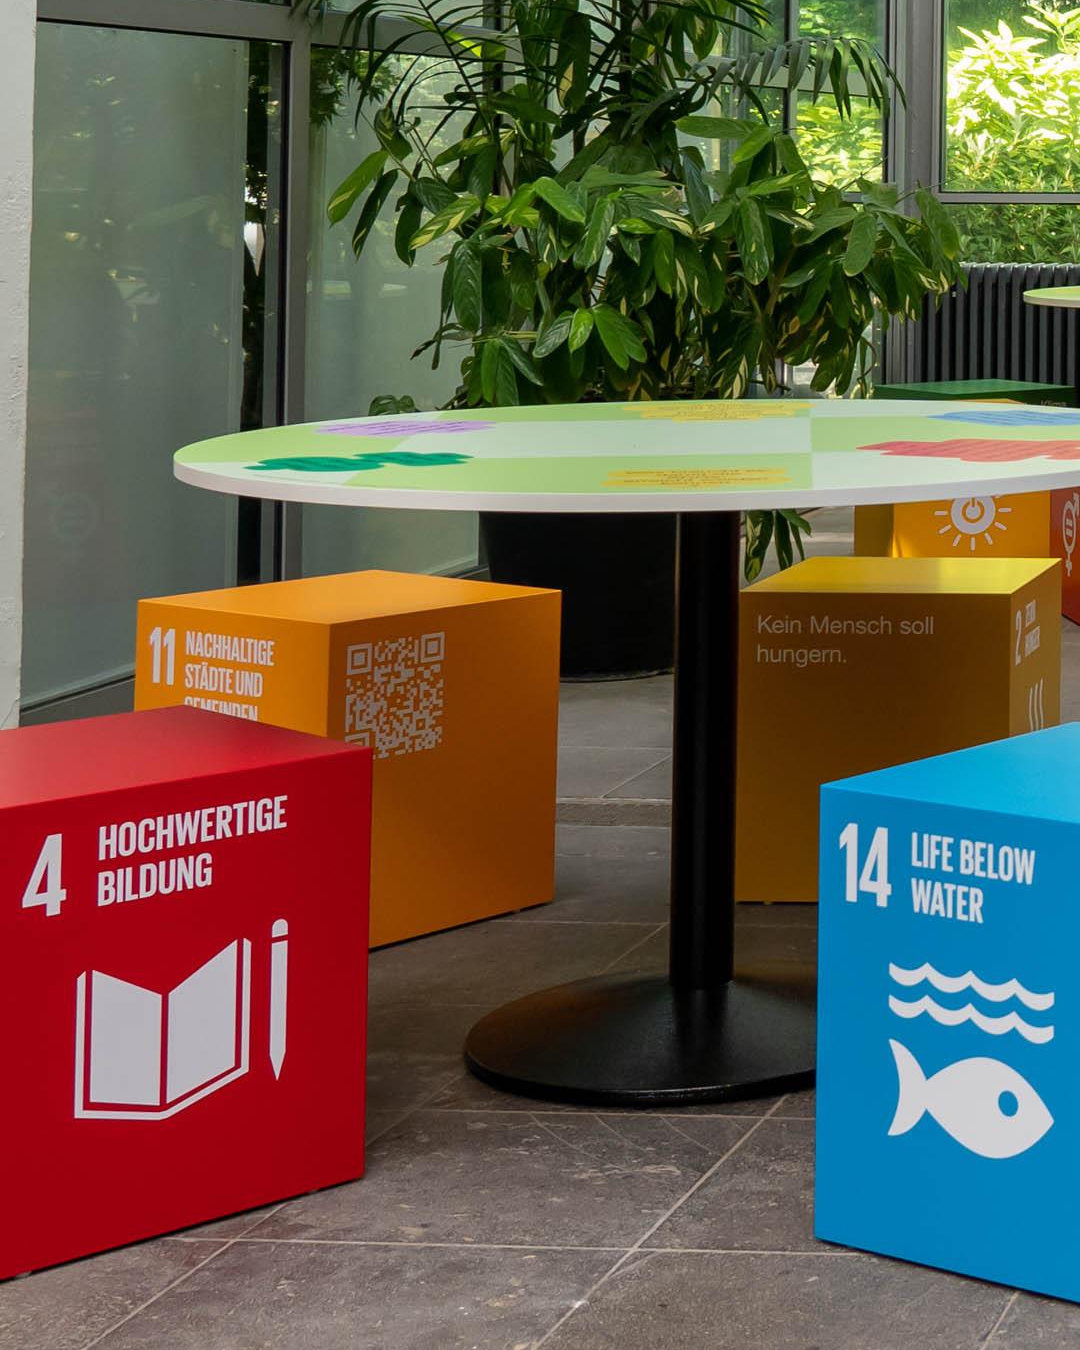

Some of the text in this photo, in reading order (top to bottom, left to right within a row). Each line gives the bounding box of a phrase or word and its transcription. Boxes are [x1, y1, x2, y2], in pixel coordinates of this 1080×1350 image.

[185, 631, 275, 666] NACHHALTIGE
[757, 614, 935, 636] Kein Mensch soll
[1014, 609, 1022, 666] 2
[150, 627, 176, 686] 11
[184, 662, 263, 698] STÄDTE UND
[756, 645, 847, 668] hungern.
[98, 795, 288, 861] HOCHWERTIGE
[22, 833, 66, 917] 4
[97, 852, 213, 907] BILDUNG
[839, 822, 892, 908] 14
[911, 832, 1036, 886] LIFE BELOW
[911, 877, 983, 924] WATER
